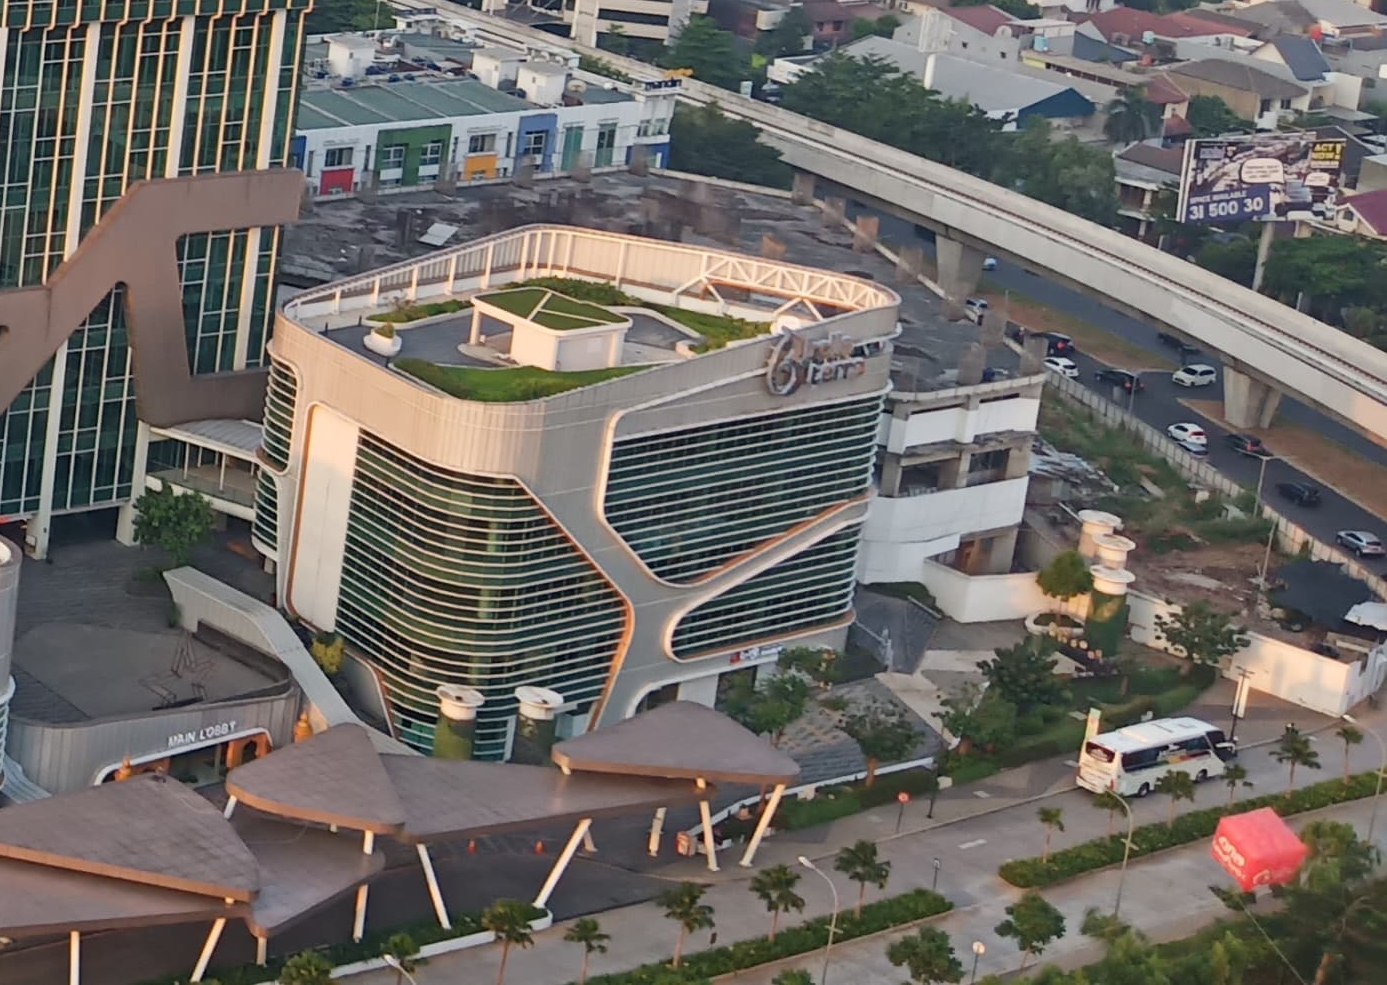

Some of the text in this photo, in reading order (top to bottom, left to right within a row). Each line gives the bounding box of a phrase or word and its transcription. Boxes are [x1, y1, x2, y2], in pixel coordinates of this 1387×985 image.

[1189, 196, 1264, 220] 31 500 30
[168, 720, 237, 746] MAIN LOBBY
